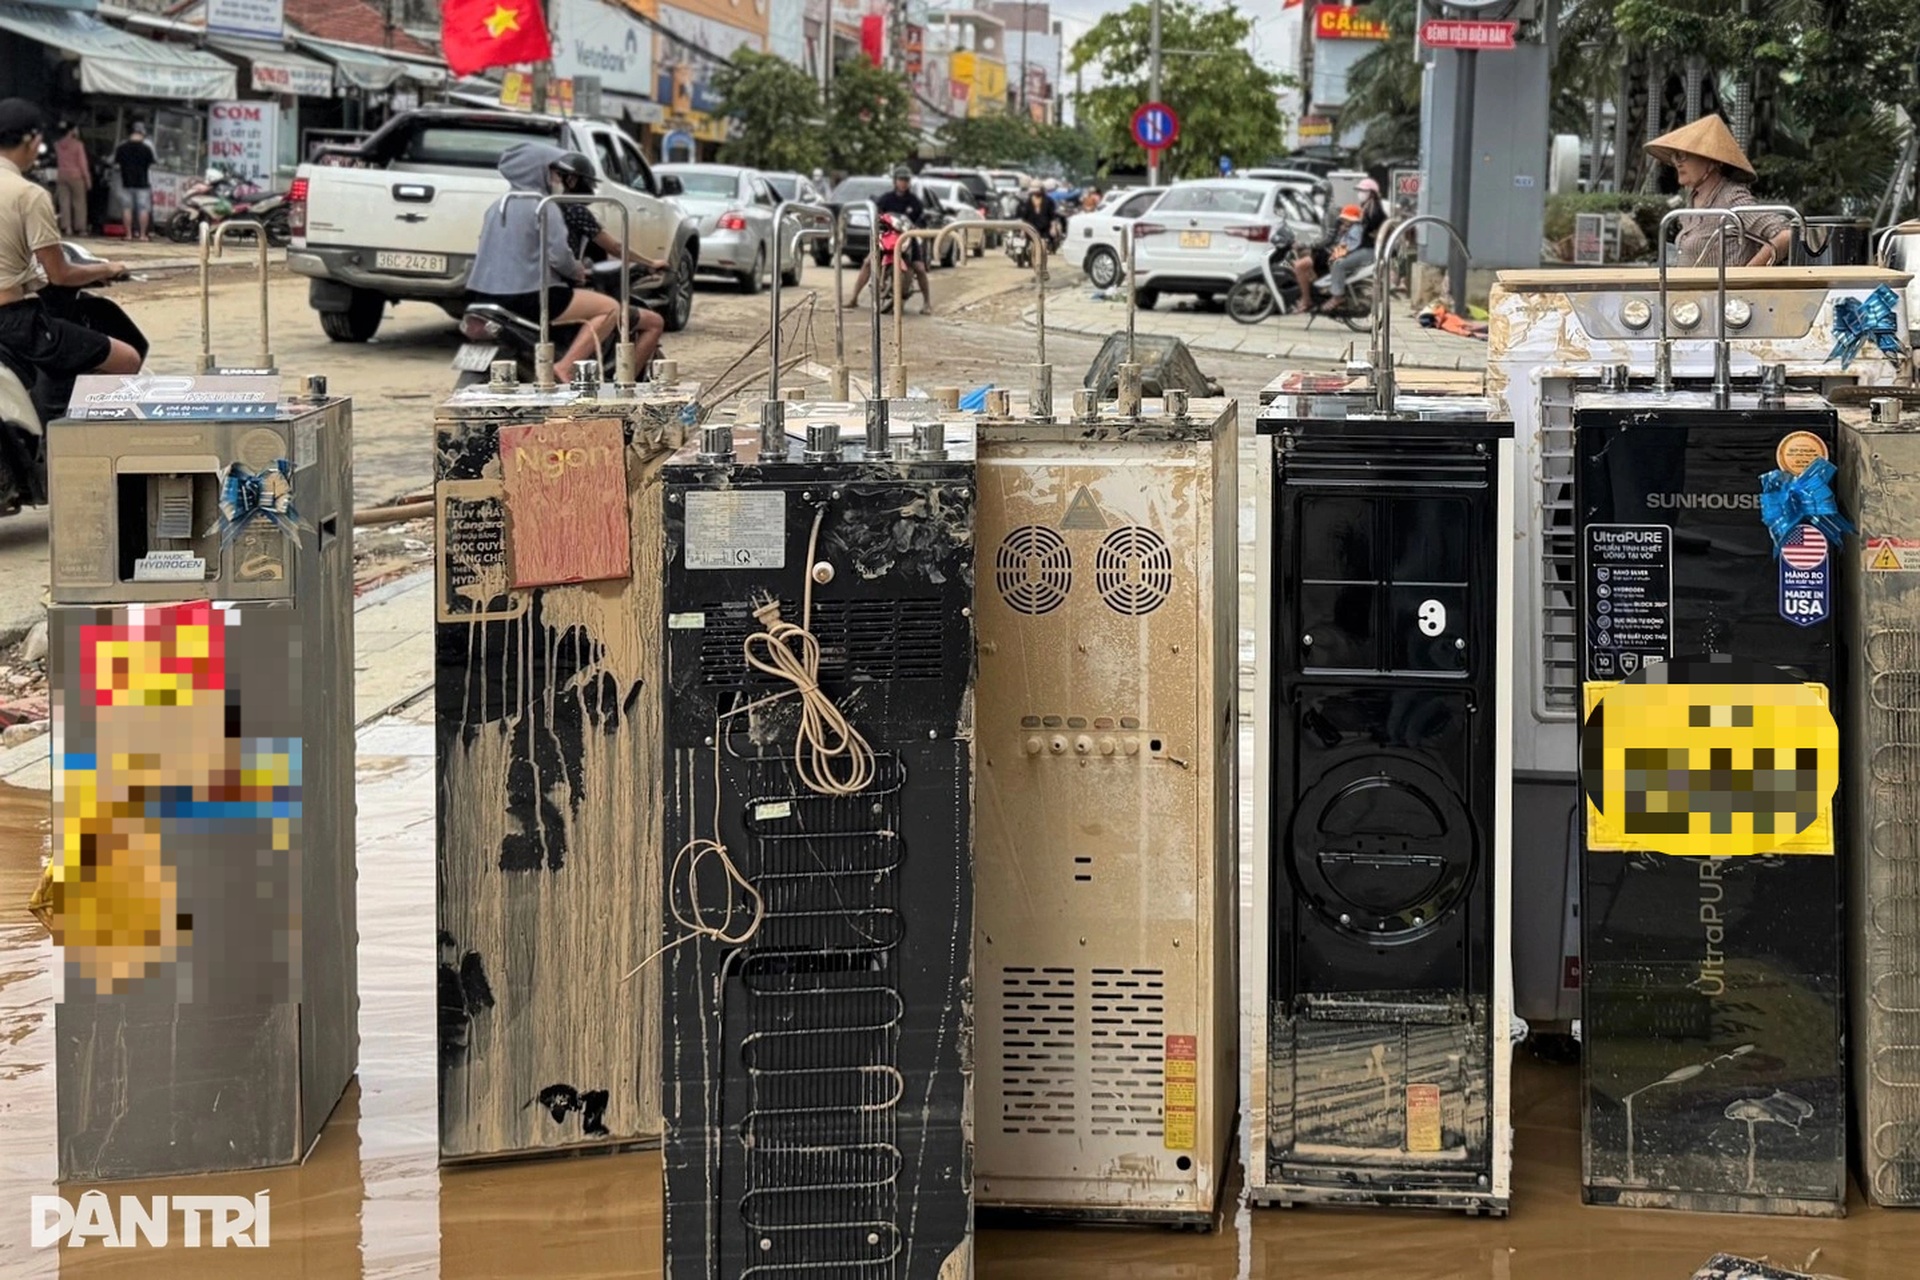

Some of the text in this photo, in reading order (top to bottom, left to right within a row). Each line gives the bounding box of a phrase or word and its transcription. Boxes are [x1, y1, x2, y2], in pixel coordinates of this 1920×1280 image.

[152, 404, 165, 417] 4
[515, 445, 611, 479] Ngon
[452, 508, 475, 519] DUY
[452, 519, 505, 532] Kangaro
[1593, 531, 1663, 543] UltraPURE
[139, 560, 202, 570] HYDROGEN
[1784, 570, 1824, 579] MÀNG RO
[1784, 590, 1824, 600] MADE IN
[1784, 599, 1824, 615] USA
[1699, 855, 1725, 997] UltraPUR
